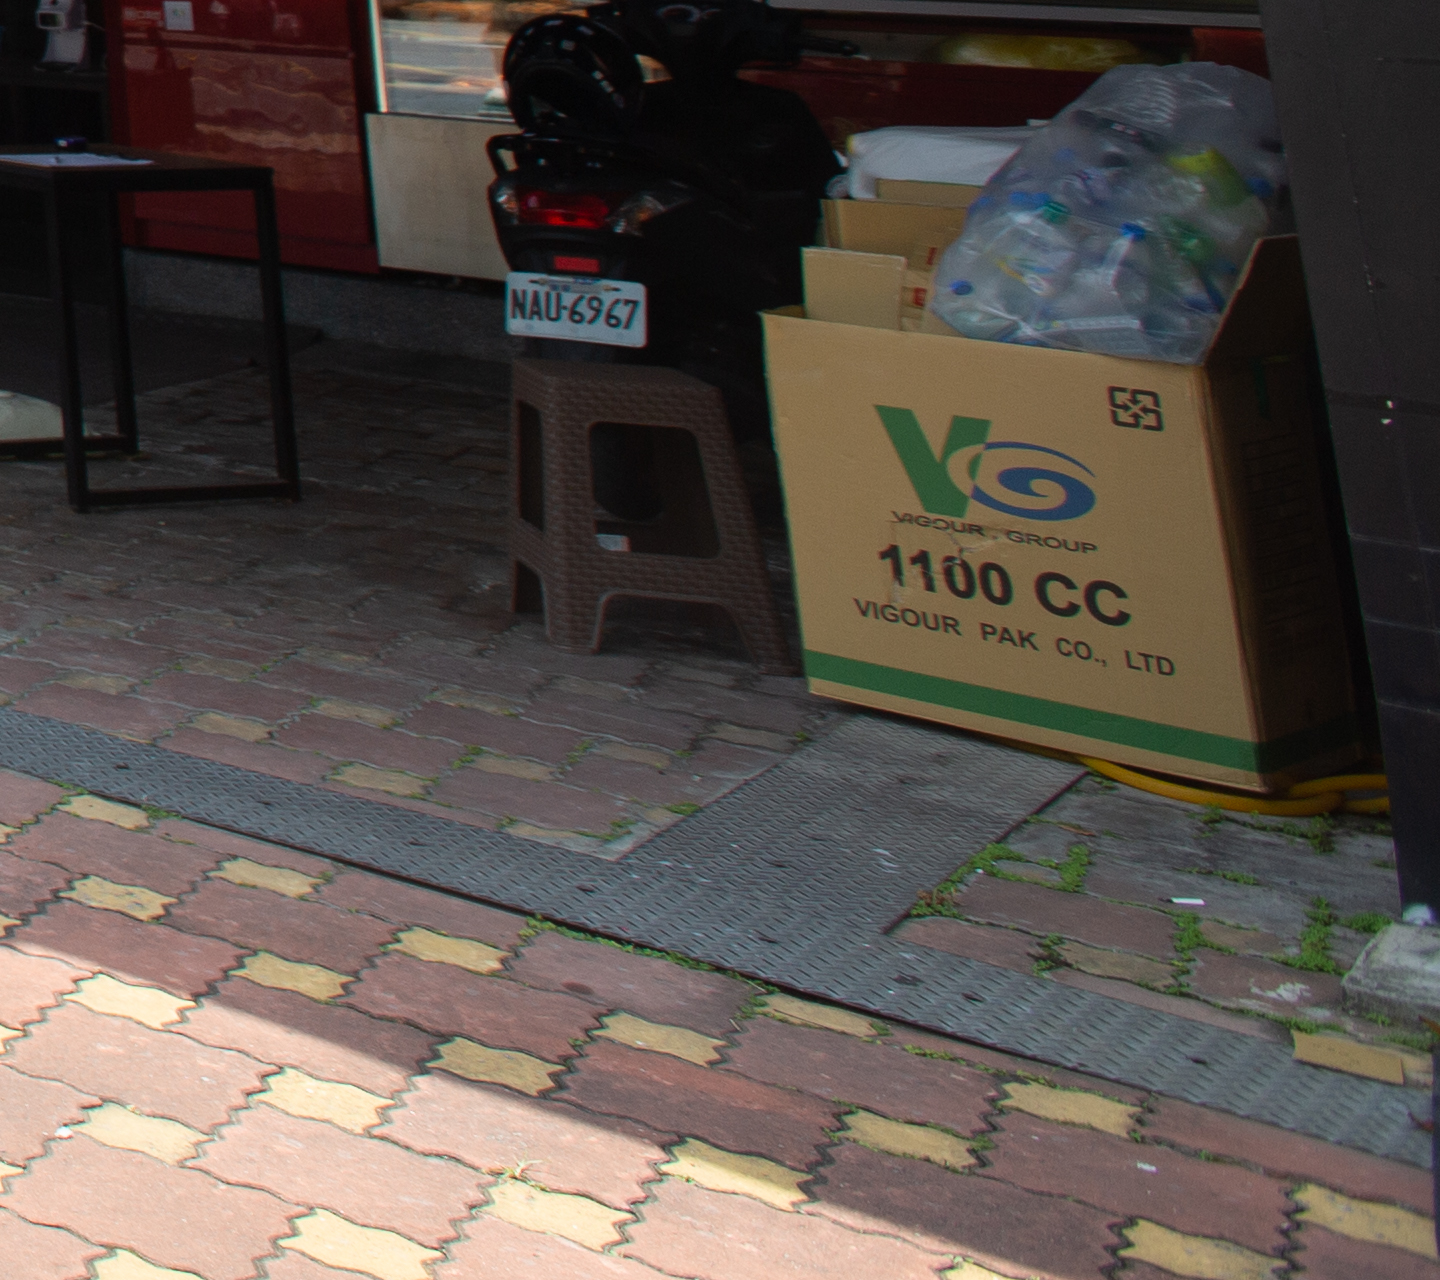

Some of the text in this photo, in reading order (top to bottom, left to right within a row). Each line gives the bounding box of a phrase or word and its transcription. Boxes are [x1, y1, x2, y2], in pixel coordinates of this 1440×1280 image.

[510, 288, 640, 330] NAU-6967
[1006, 530, 1098, 554] GROUP
[878, 543, 1131, 628] 1100 CC
[853, 597, 962, 637] VIGOUR
[979, 622, 1040, 652] PAK
[1124, 649, 1176, 677] LTD
